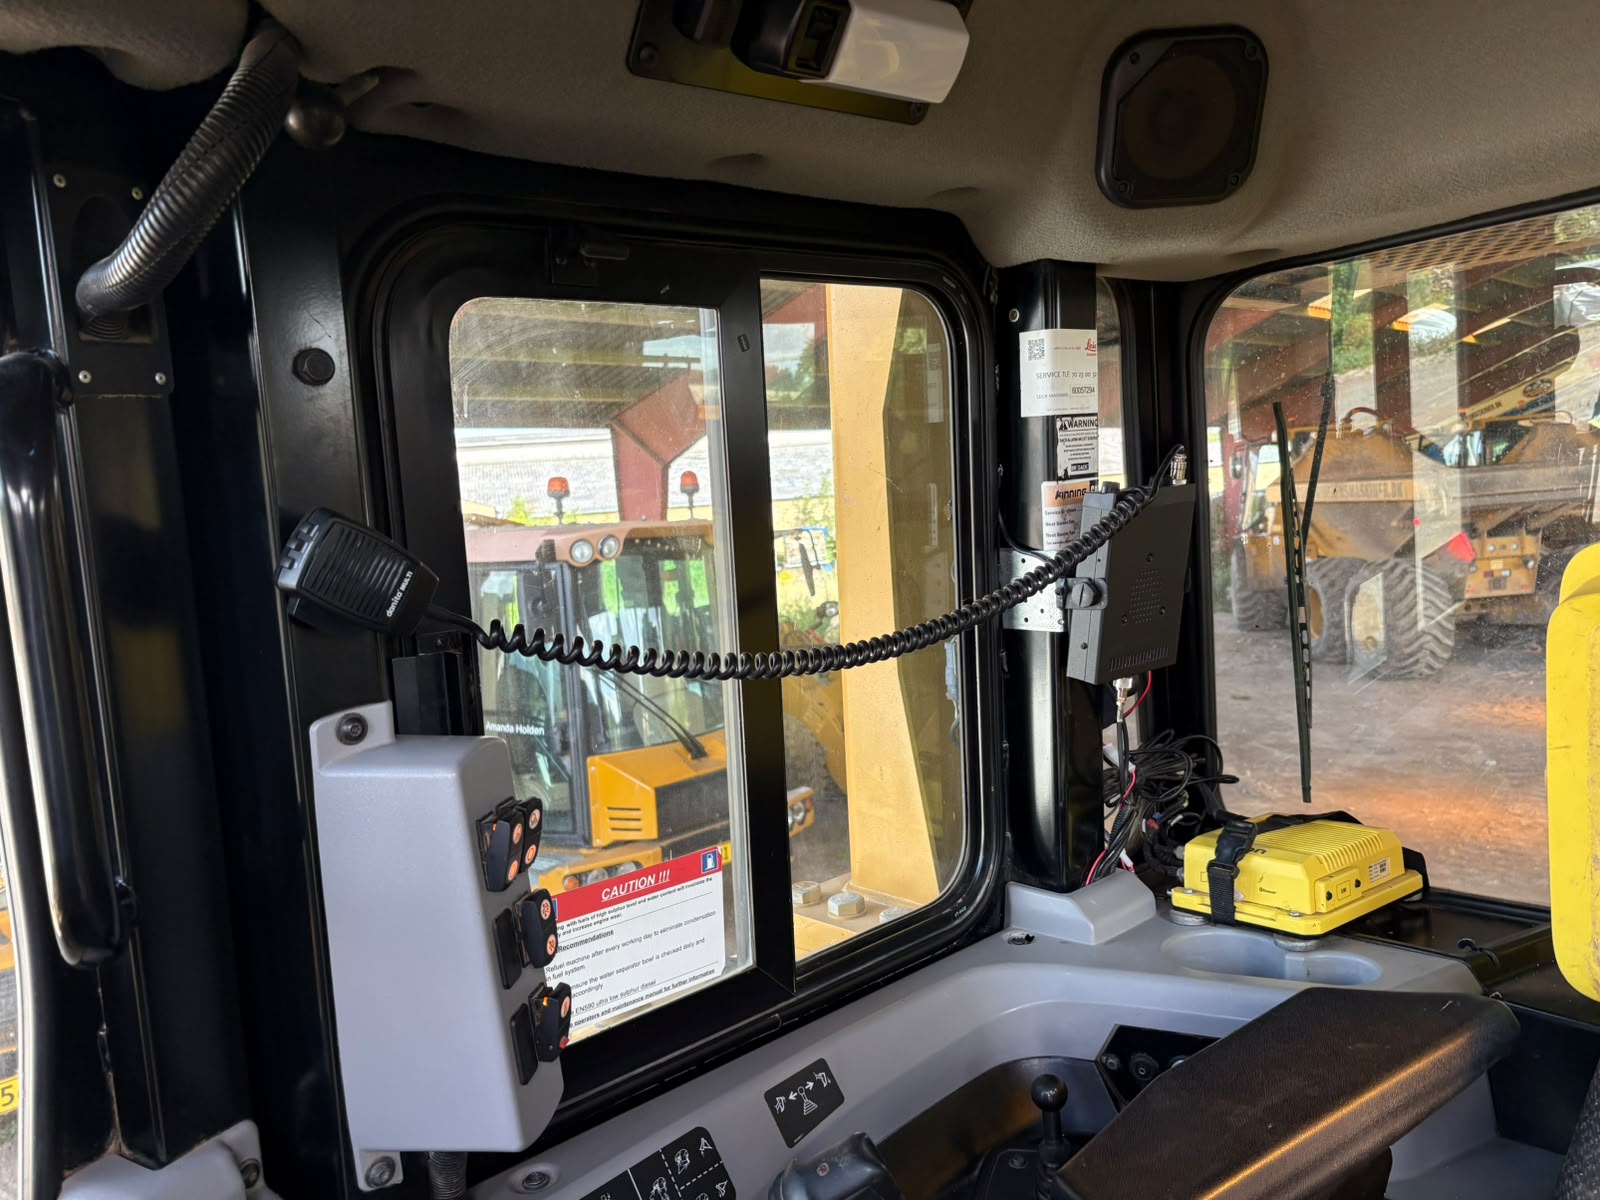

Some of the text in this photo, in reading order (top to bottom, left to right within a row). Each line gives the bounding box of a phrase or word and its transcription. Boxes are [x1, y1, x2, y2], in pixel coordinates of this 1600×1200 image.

[1036, 371, 1060, 379] SERVICE
[486, 720, 514, 733] Amanda
[601, 869, 671, 900] CAUTION !!!
[566, 920, 577, 928] with
[572, 923, 592, 932] increase
[593, 917, 609, 926] engine
[558, 930, 614, 952] Recommendations
[546, 962, 565, 973] Refuel
[566, 954, 590, 966] machine
[591, 949, 604, 958] after
[605, 944, 620, 954] every
[622, 936, 642, 948] working
[643, 932, 653, 940] day
[571, 980, 588, 990] nsure
[599, 970, 614, 979] water
[615, 961, 641, 974] separator
[641, 955, 654, 965] bowl
[660, 946, 682, 958] checked
[683, 941, 694, 950] daily
[695, 937, 705, 945] and
[552, 971, 563, 979] fuel
[564, 964, 585, 976] system
[575, 1001, 595, 1014] EN590
[609, 993, 619, 1001] low
[640, 979, 656, 990] diesel
[574, 1012, 599, 1026] operators
[601, 1008, 612, 1016] and
[611, 996, 644, 1013] maintenance
